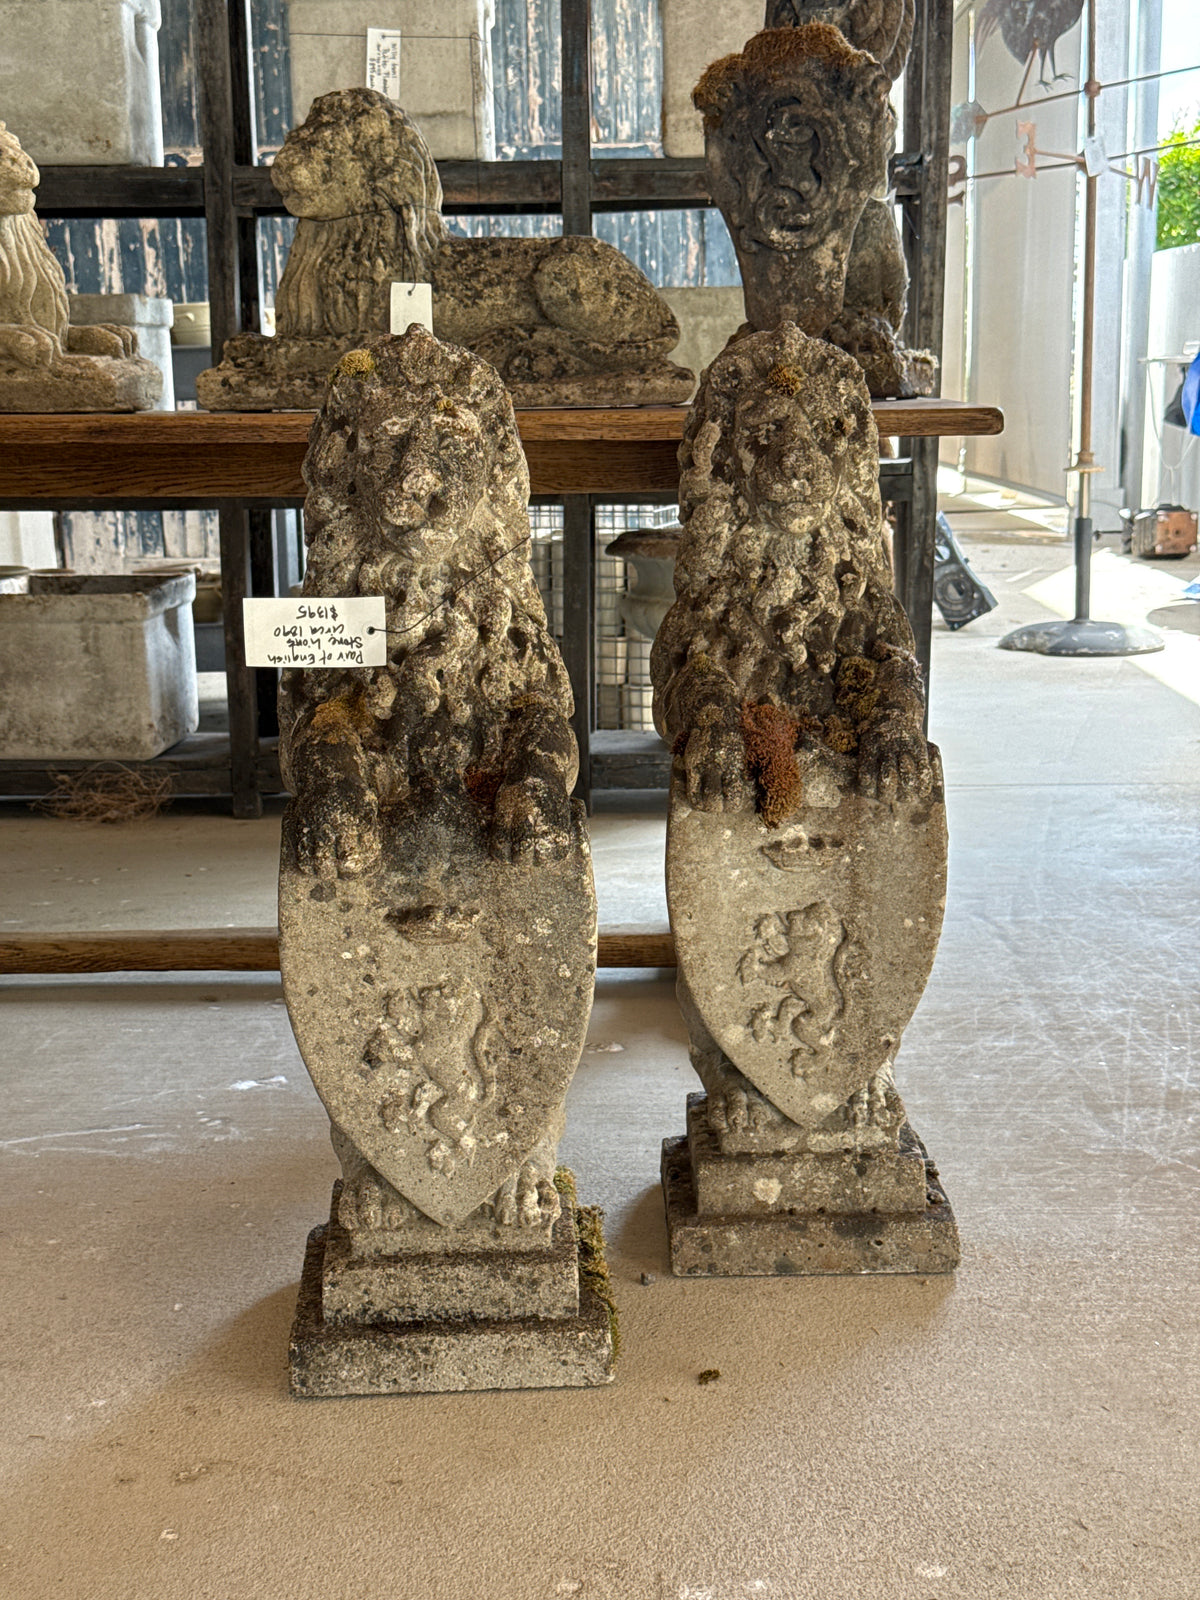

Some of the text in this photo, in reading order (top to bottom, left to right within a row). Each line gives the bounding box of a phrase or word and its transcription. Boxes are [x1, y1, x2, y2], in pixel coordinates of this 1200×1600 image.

[295, 604, 339, 621] $1395
[273, 623, 345, 637] circa 1890
[328, 636, 364, 649] Stone
[267, 645, 364, 665] Pair of English
